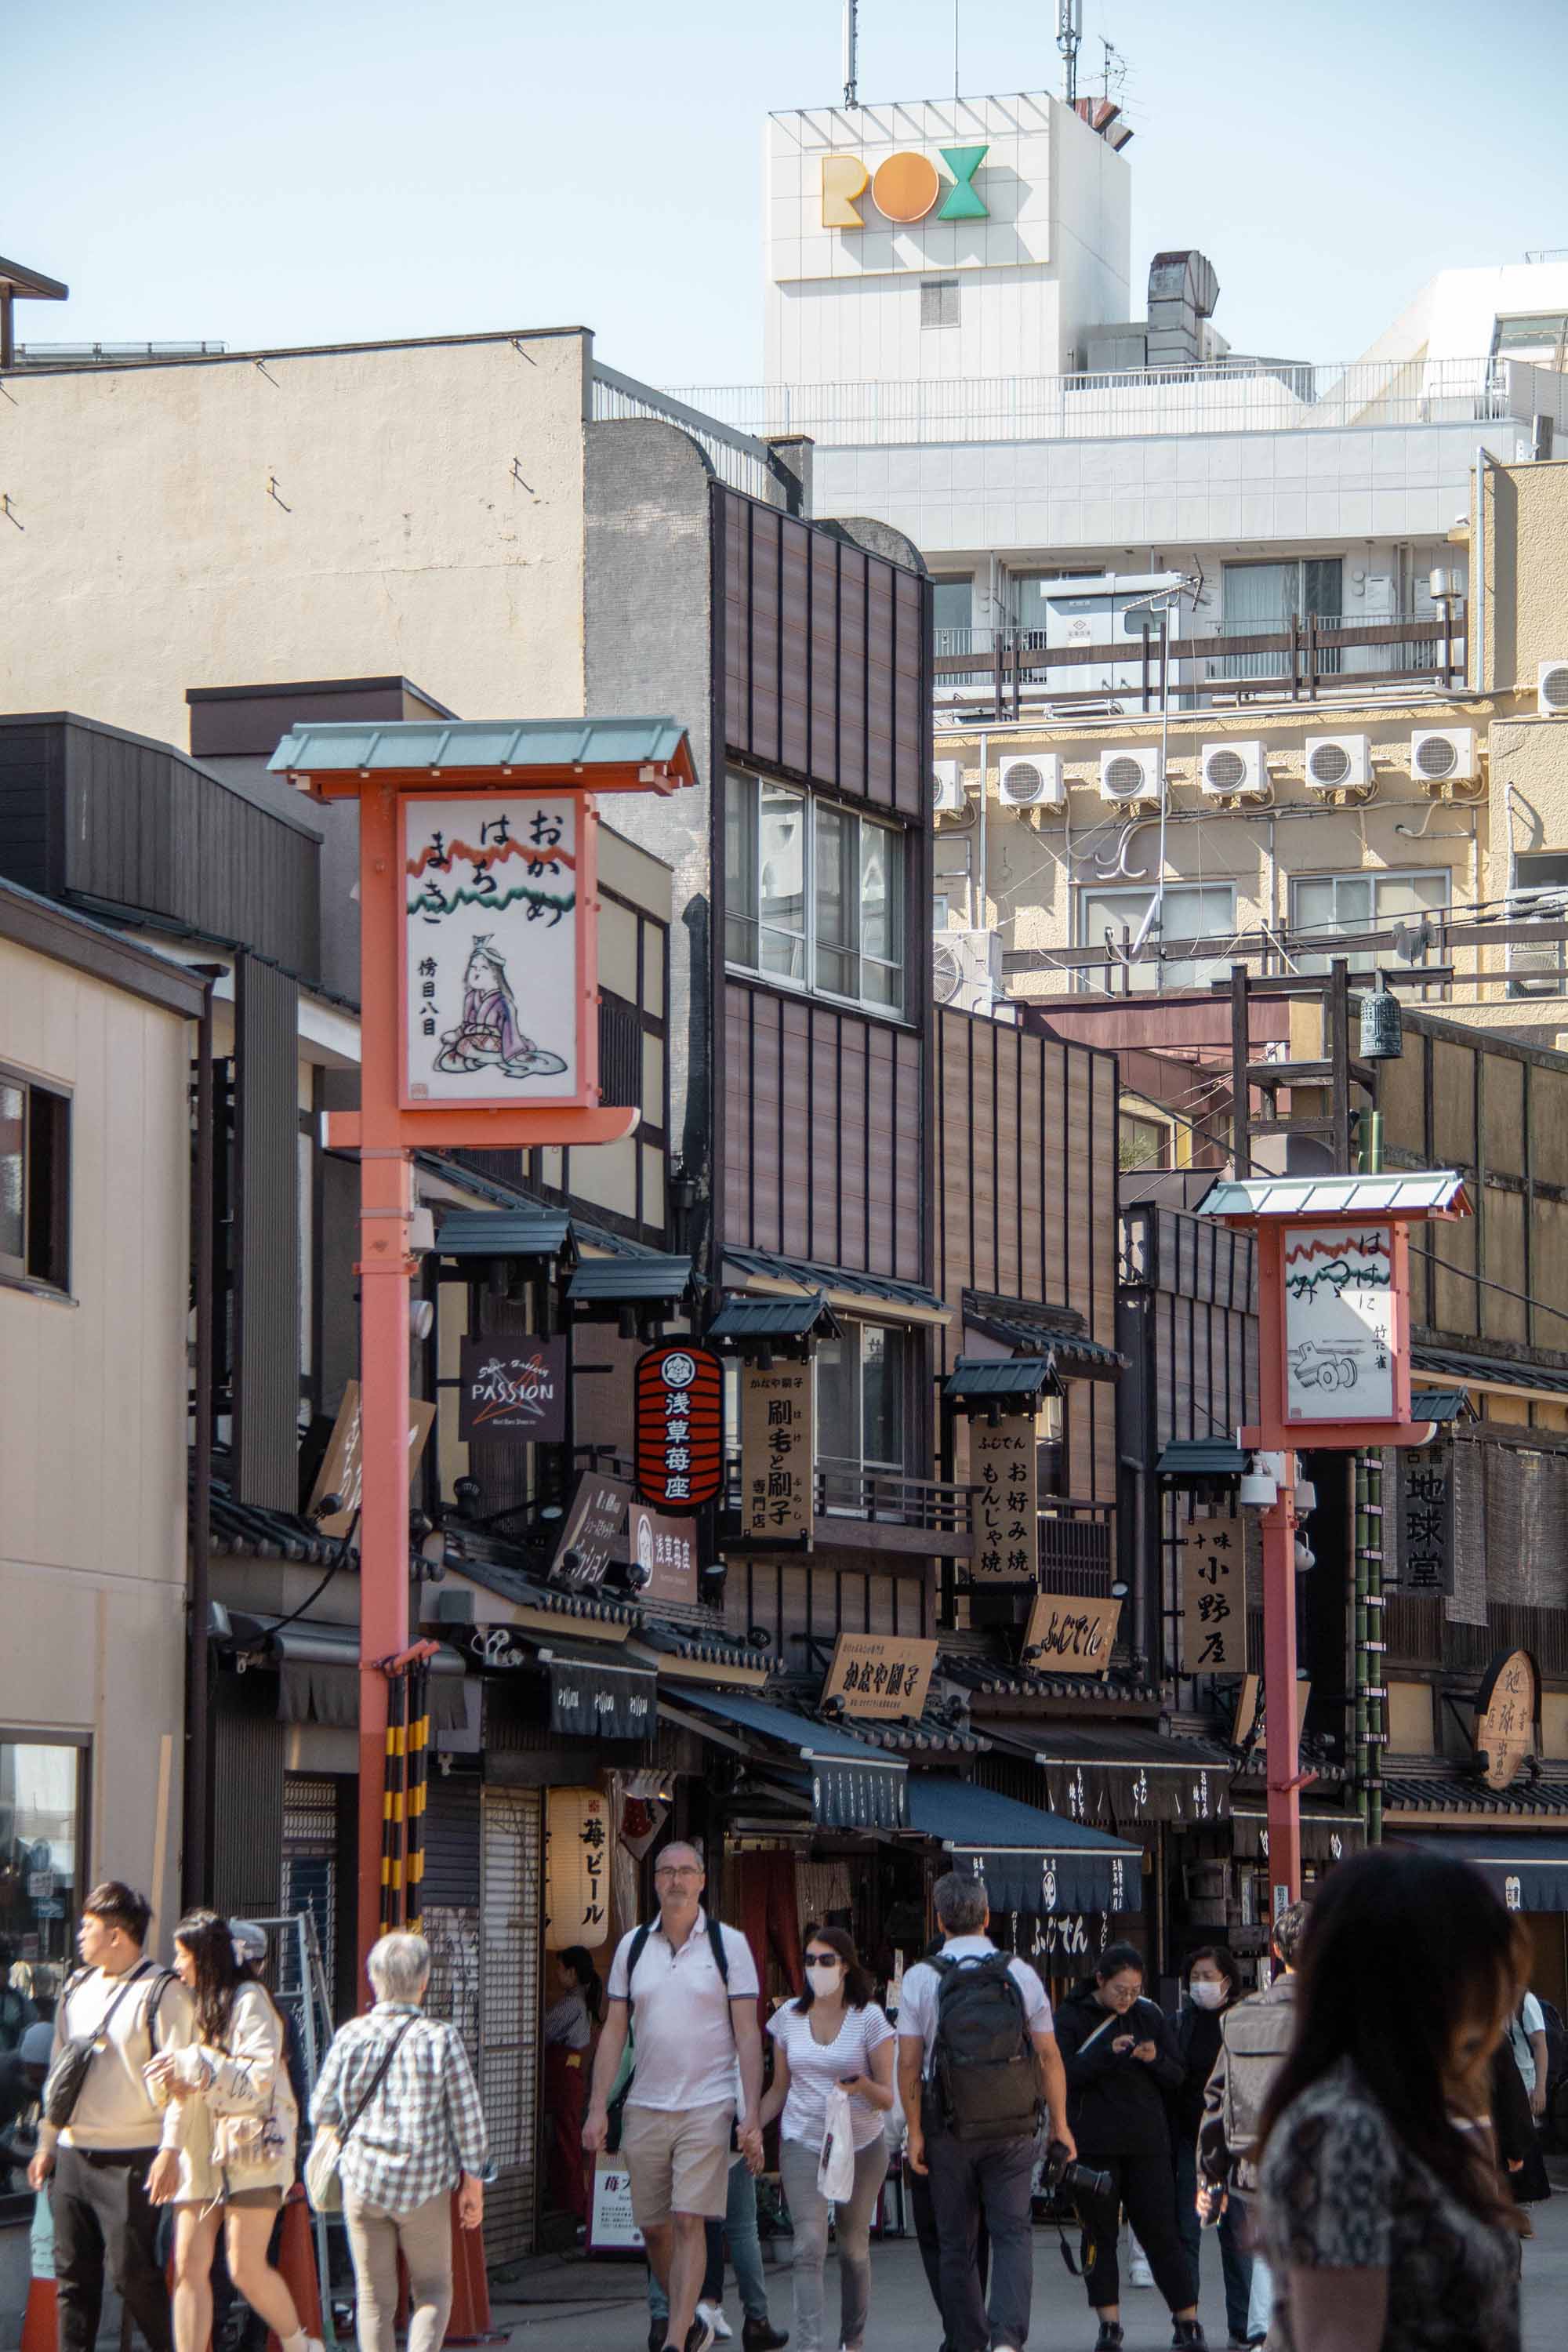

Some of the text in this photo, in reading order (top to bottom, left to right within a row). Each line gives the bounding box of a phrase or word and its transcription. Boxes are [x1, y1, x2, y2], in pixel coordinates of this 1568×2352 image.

[822, 145, 990, 228] ROX
[423, 831, 449, 924] まき
[472, 814, 510, 895] はち
[526, 809, 564, 928] おかめ
[417, 956, 440, 1036] 傍目八目
[471, 1381, 554, 1403] PASSION
[665, 1392, 691, 1500] 浅草苺座
[752, 1479, 766, 1529] 専門店
[768, 1399, 793, 1526] 刷毛と刷子
[1006, 1461, 1029, 1572] お好み焼
[655, 1533, 691, 1570] 浅草苺座
[981, 1463, 1004, 1573] もんじゃ焼
[1406, 1468, 1445, 1588] 地球堂
[1197, 1555, 1231, 1664] 小野屋
[578, 1817, 605, 1926] 苺ビール
